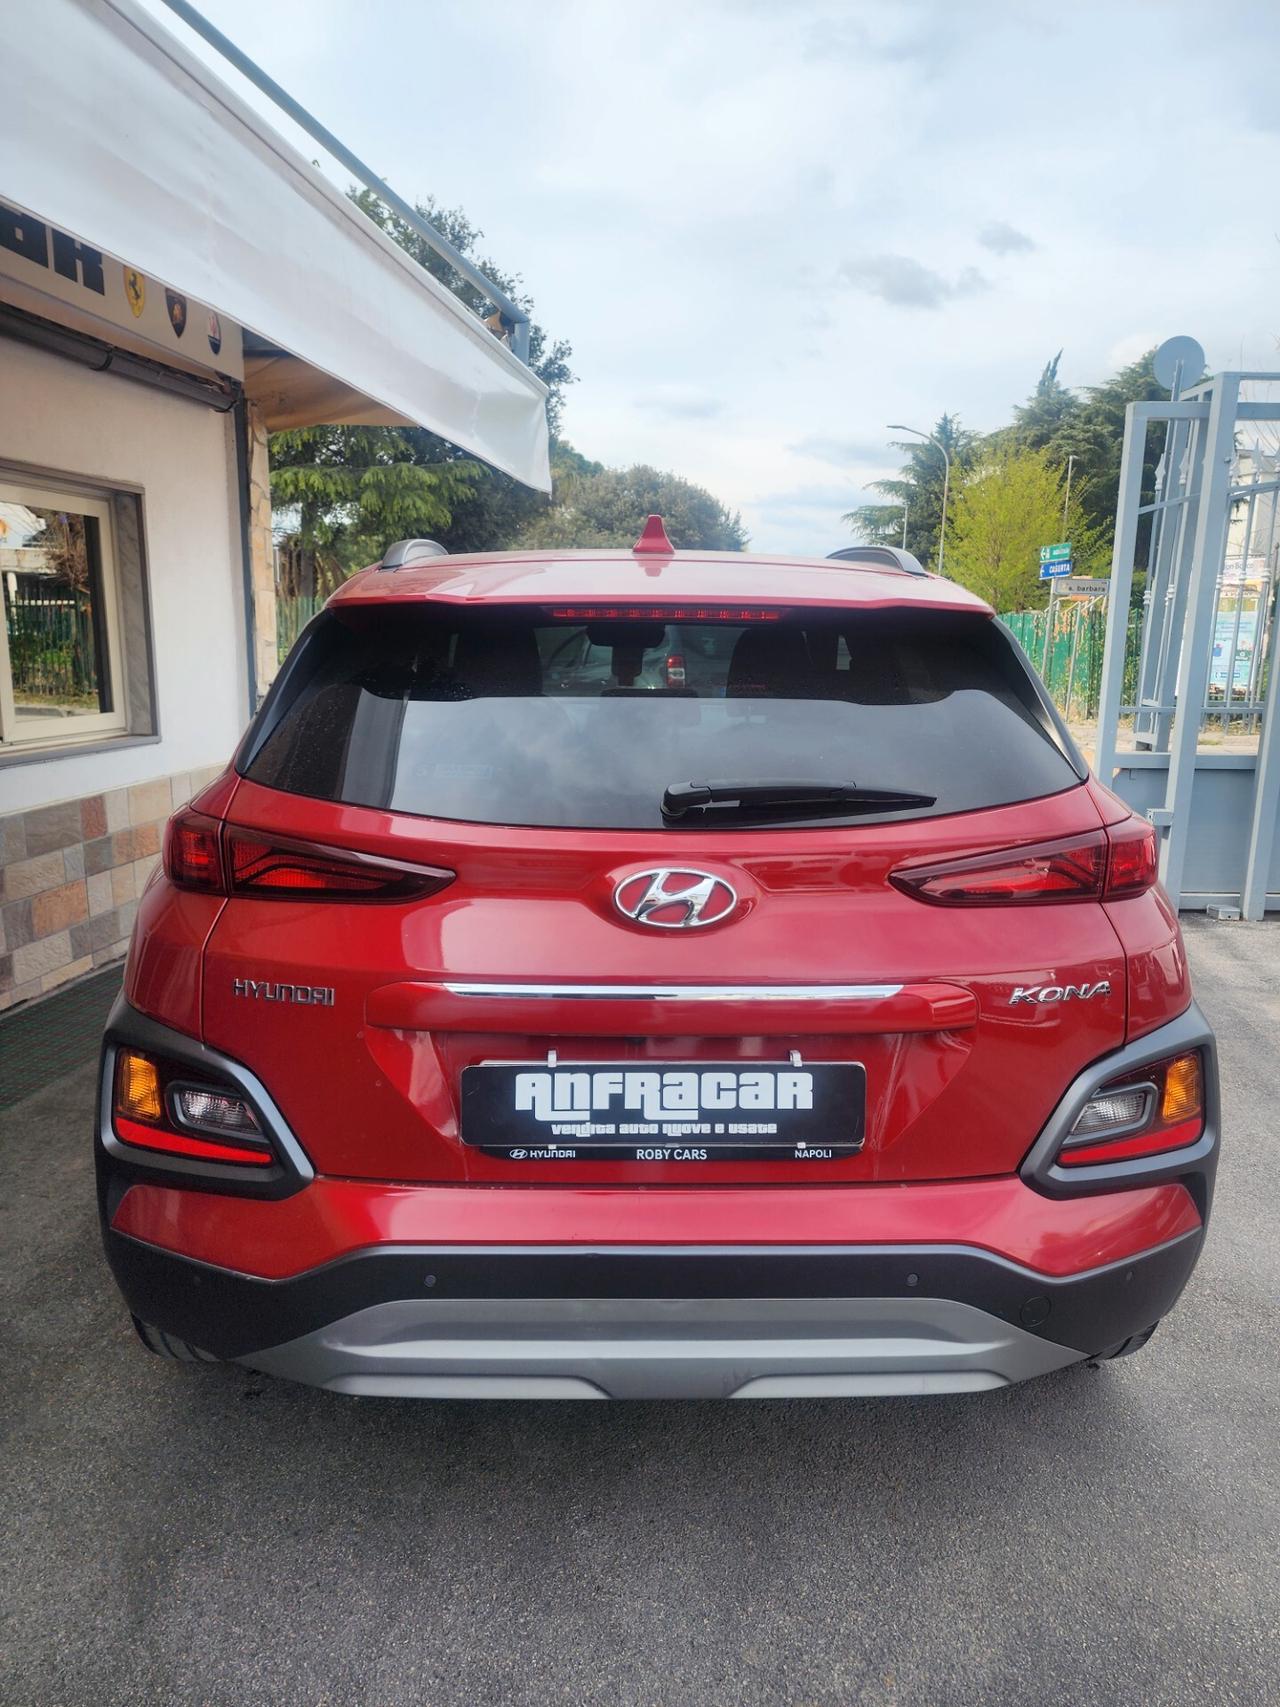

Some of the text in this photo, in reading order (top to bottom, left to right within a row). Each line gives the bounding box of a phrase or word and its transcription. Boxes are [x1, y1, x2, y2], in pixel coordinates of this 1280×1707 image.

[1077, 584, 1106, 592] barbara
[233, 978, 335, 1006] HYUNDAI
[1008, 980, 1111, 1004] KONA
[619, 1123, 658, 1134] auto
[728, 1123, 777, 1134] usate
[529, 1149, 832, 1160] HYUNDAI ROBY CARS NAPOLI
